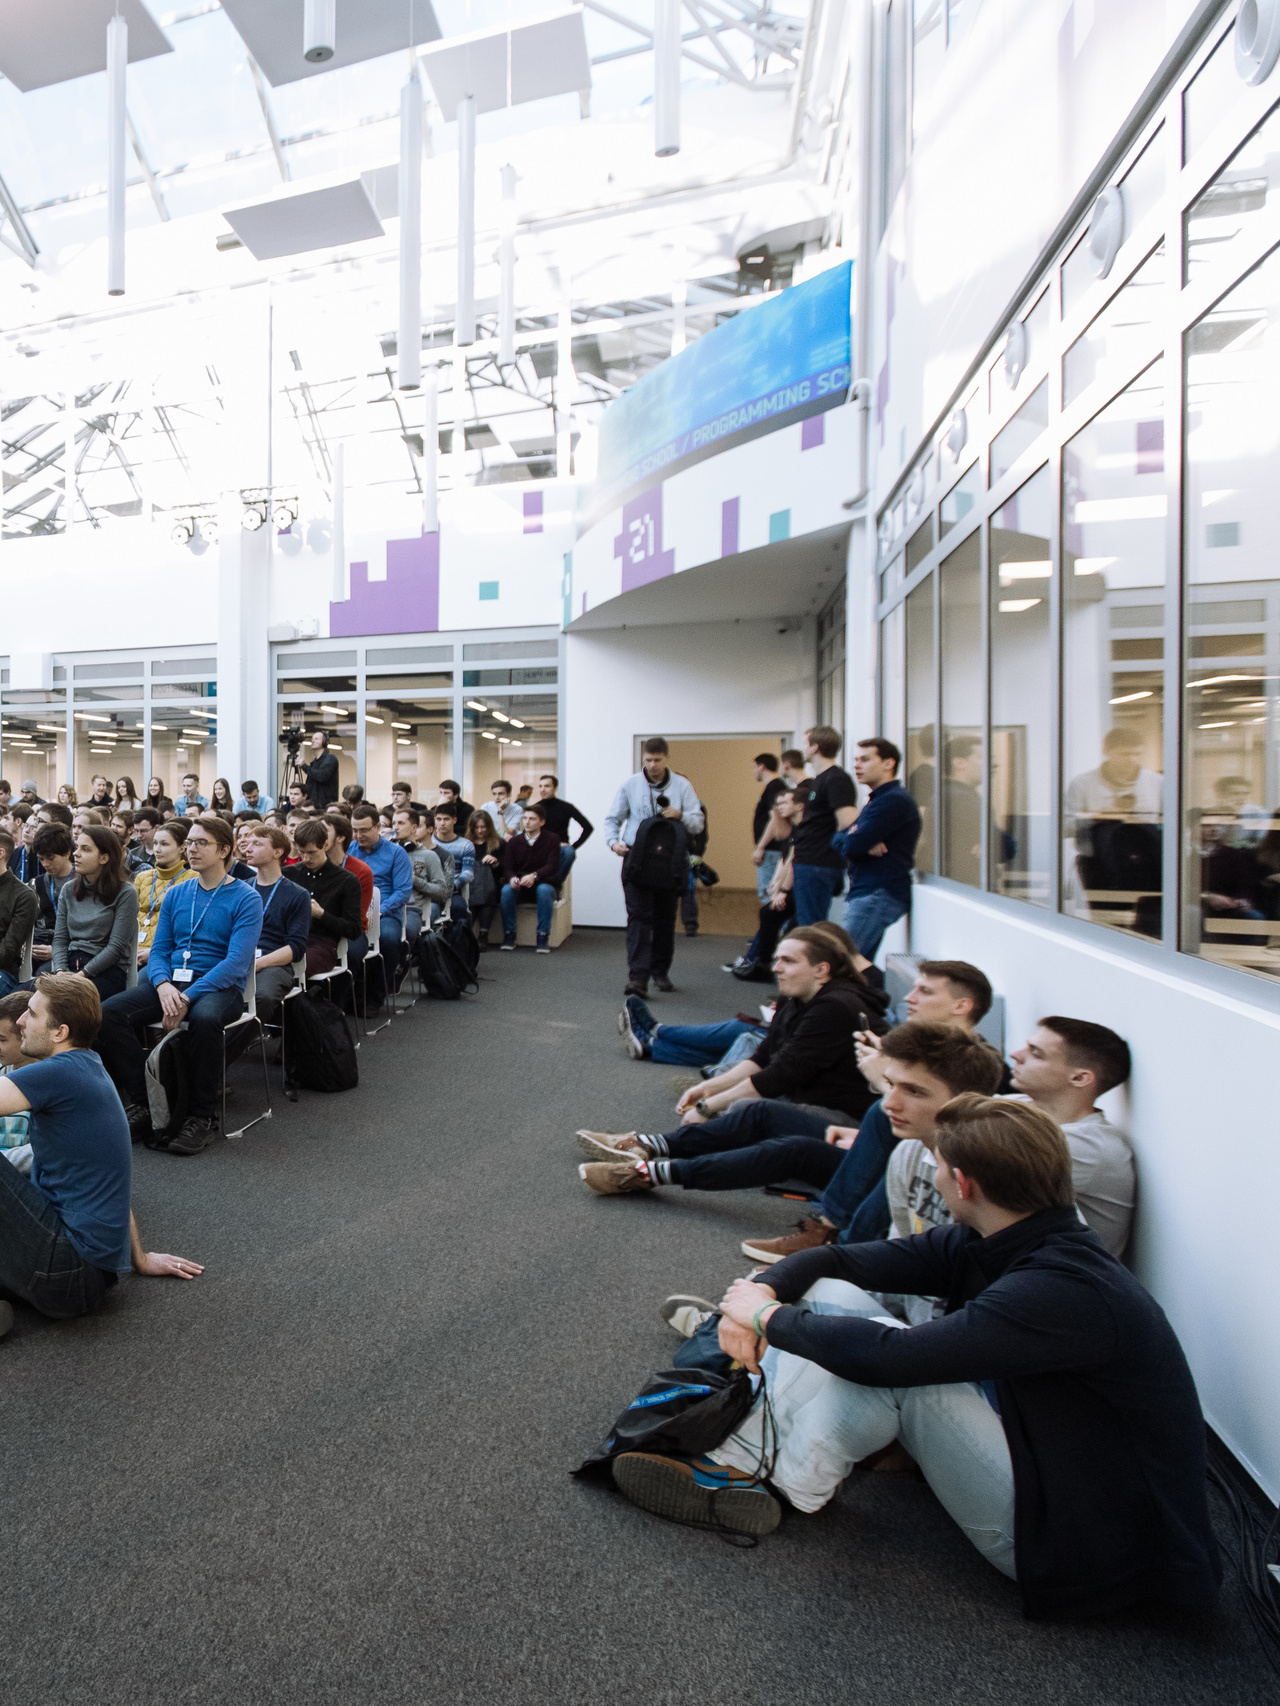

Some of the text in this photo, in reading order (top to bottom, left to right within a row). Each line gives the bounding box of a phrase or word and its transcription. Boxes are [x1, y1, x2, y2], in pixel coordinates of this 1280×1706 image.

[641, 442, 679, 478] SCHOOL
[693, 381, 811, 447] PROGRAMMING
[629, 513, 654, 564] 21
